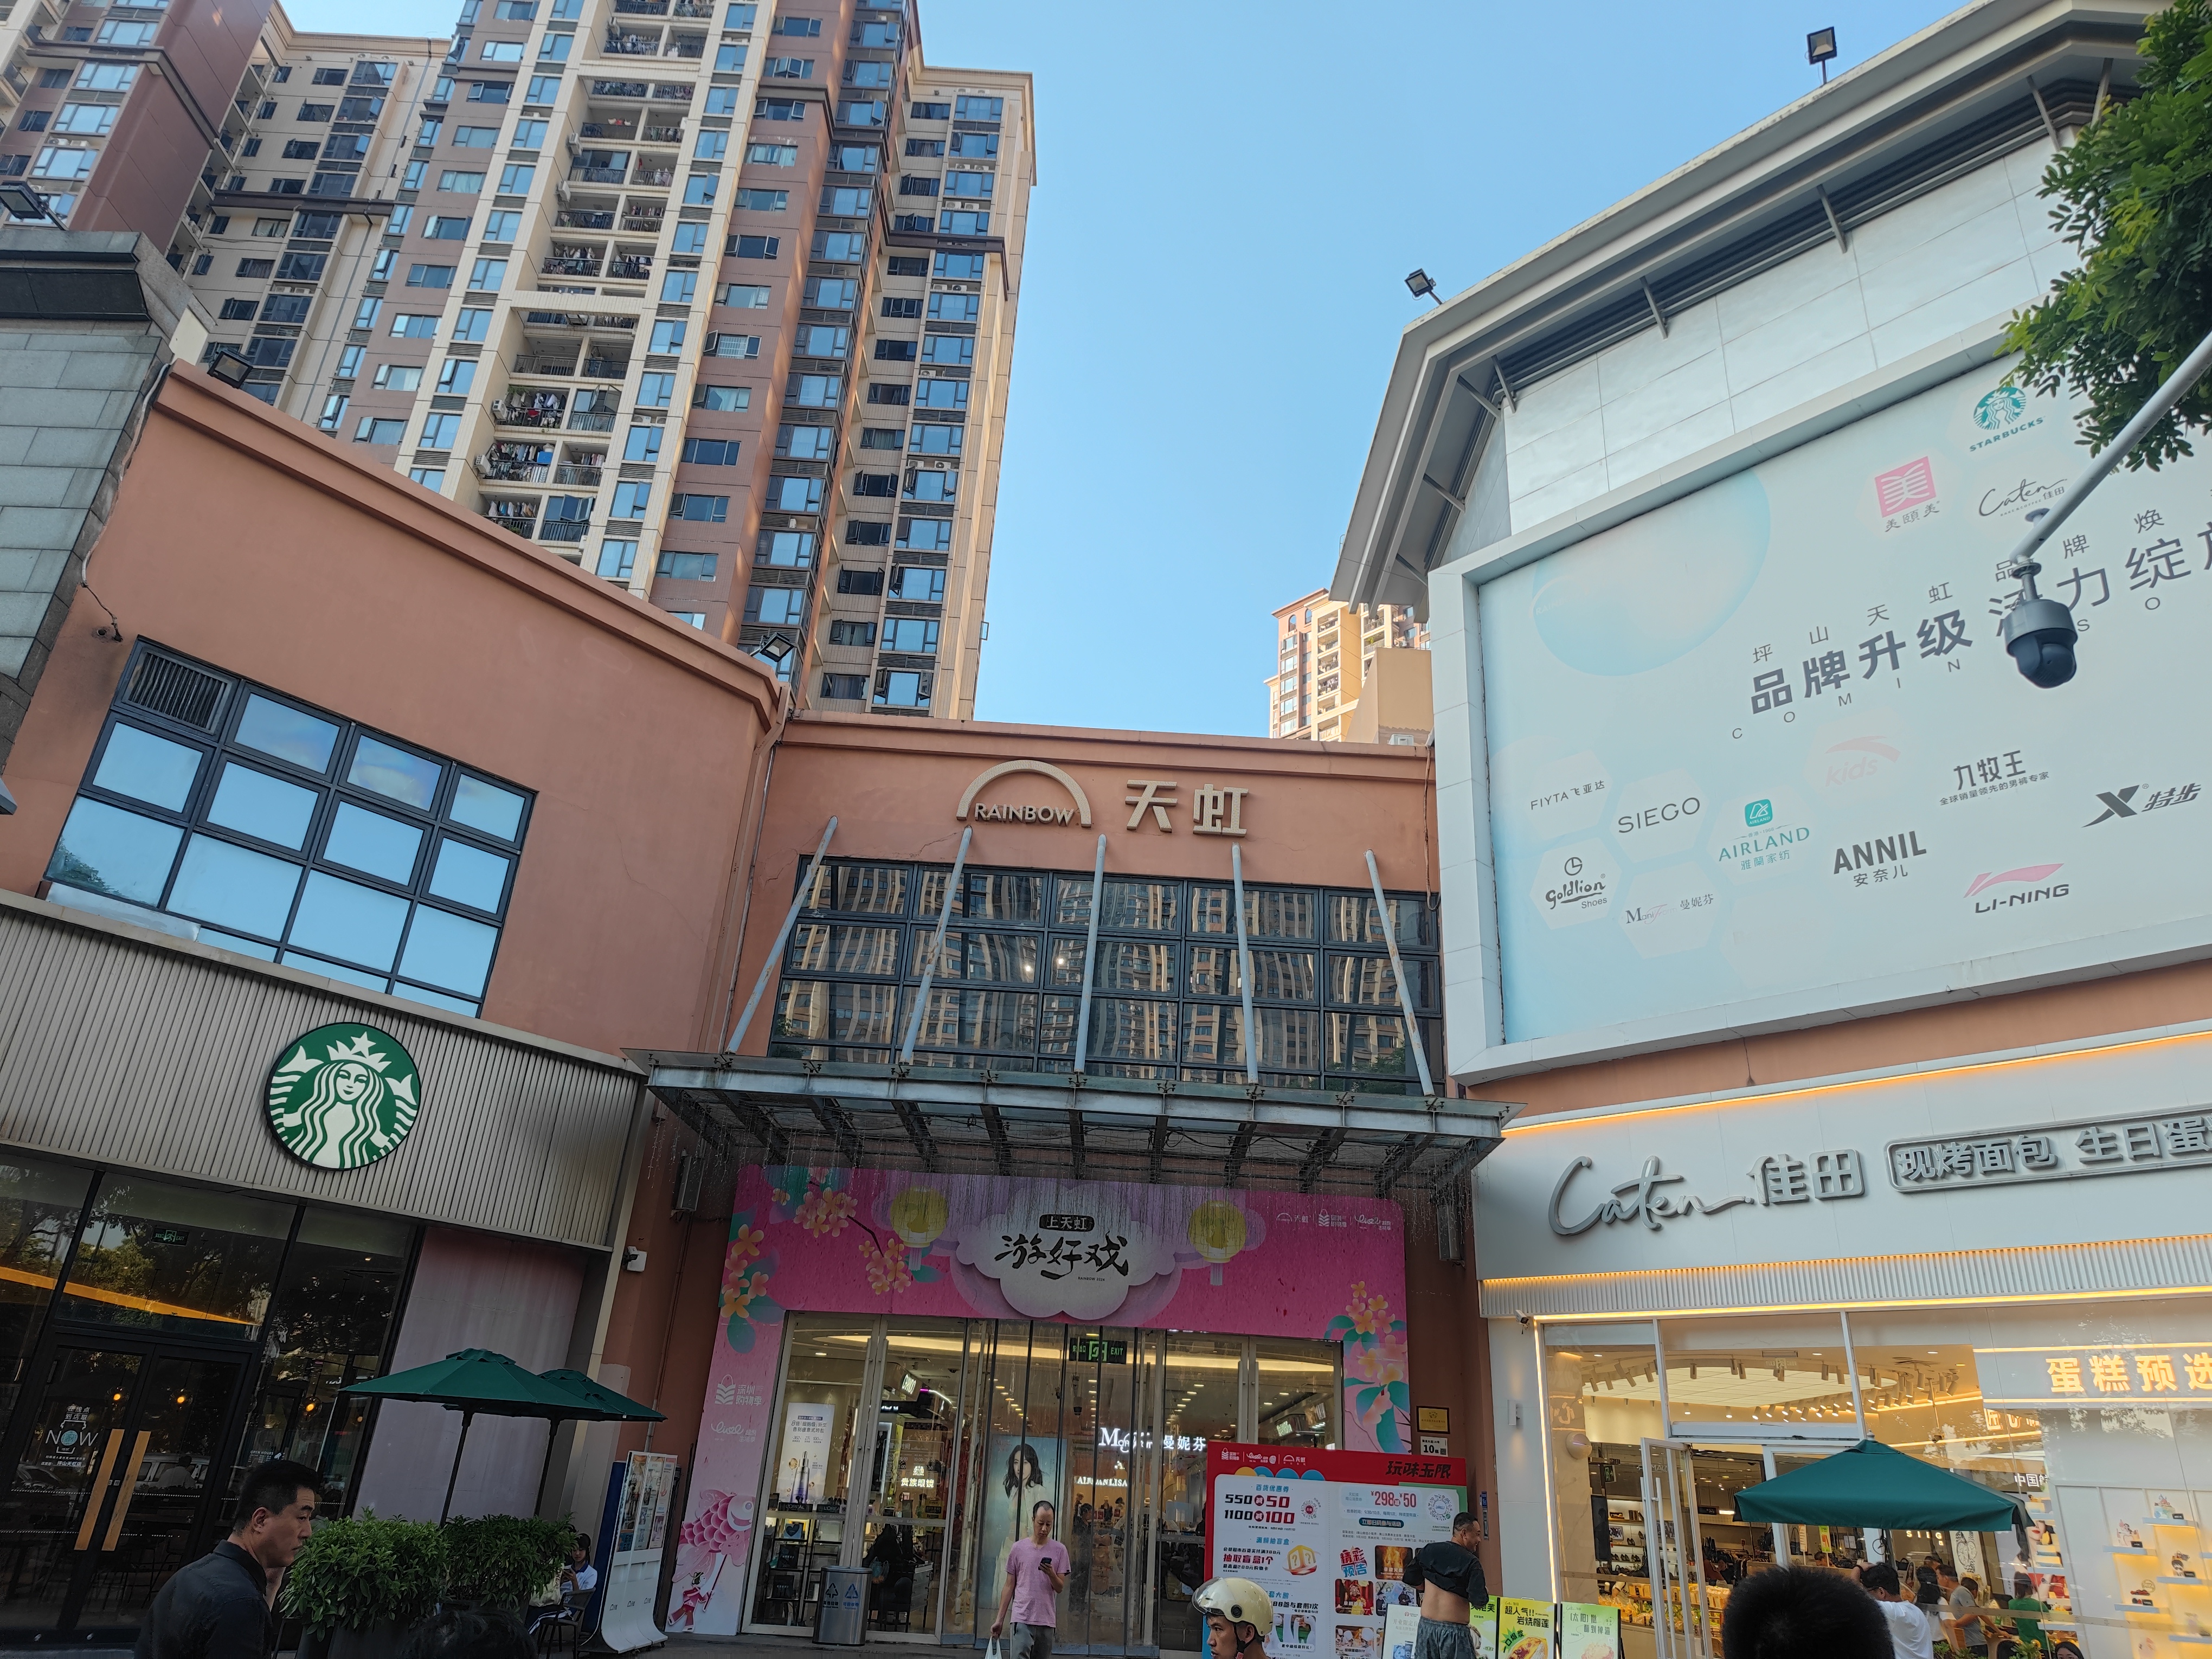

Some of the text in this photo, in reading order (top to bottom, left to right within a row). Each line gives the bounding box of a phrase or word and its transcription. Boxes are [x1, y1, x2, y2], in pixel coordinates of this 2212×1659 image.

[1970, 416, 2043, 452] STARBUCKS
[2043, 486, 2065, 501] 佳田
[1825, 756, 1879, 787] kids
[1953, 750, 2027, 790] 九牧王
[1531, 780, 1605, 810] FIYTA 飞亚达
[1939, 771, 2049, 806] 全球销量领先的男裤专家
[2141, 782, 2201, 813] 特步
[974, 802, 1076, 827] RAINBOW
[1125, 779, 1249, 838] 天虹
[1618, 797, 1701, 834] SIEGO
[1719, 827, 1810, 861] AIRLAND
[1833, 831, 1927, 874] ANNIL
[1853, 864, 1908, 888] 安奈儿
[1581, 896, 1607, 909] Shoes
[1680, 893, 1714, 911] 曼妮芬
[1975, 884, 2070, 914] LI-NING
[1896, 1114, 2212, 1181] 现烤面包 生日蛋
[1747, 1149, 1866, 1206] 佳田
[1548, 1155, 1755, 1237] Caten
[1046, 1214, 1088, 1231] 上天虹
[1110, 1347, 1123, 1355] EXIT
[735, 1395, 762, 1406] 购物季
[737, 1384, 755, 1395] 深圳
[1163, 1435, 1206, 1451] 曼妮芬
[1385, 1461, 1452, 1479] 玩味无限
[1517, 1616, 1549, 1628] 岩烧榴莲
